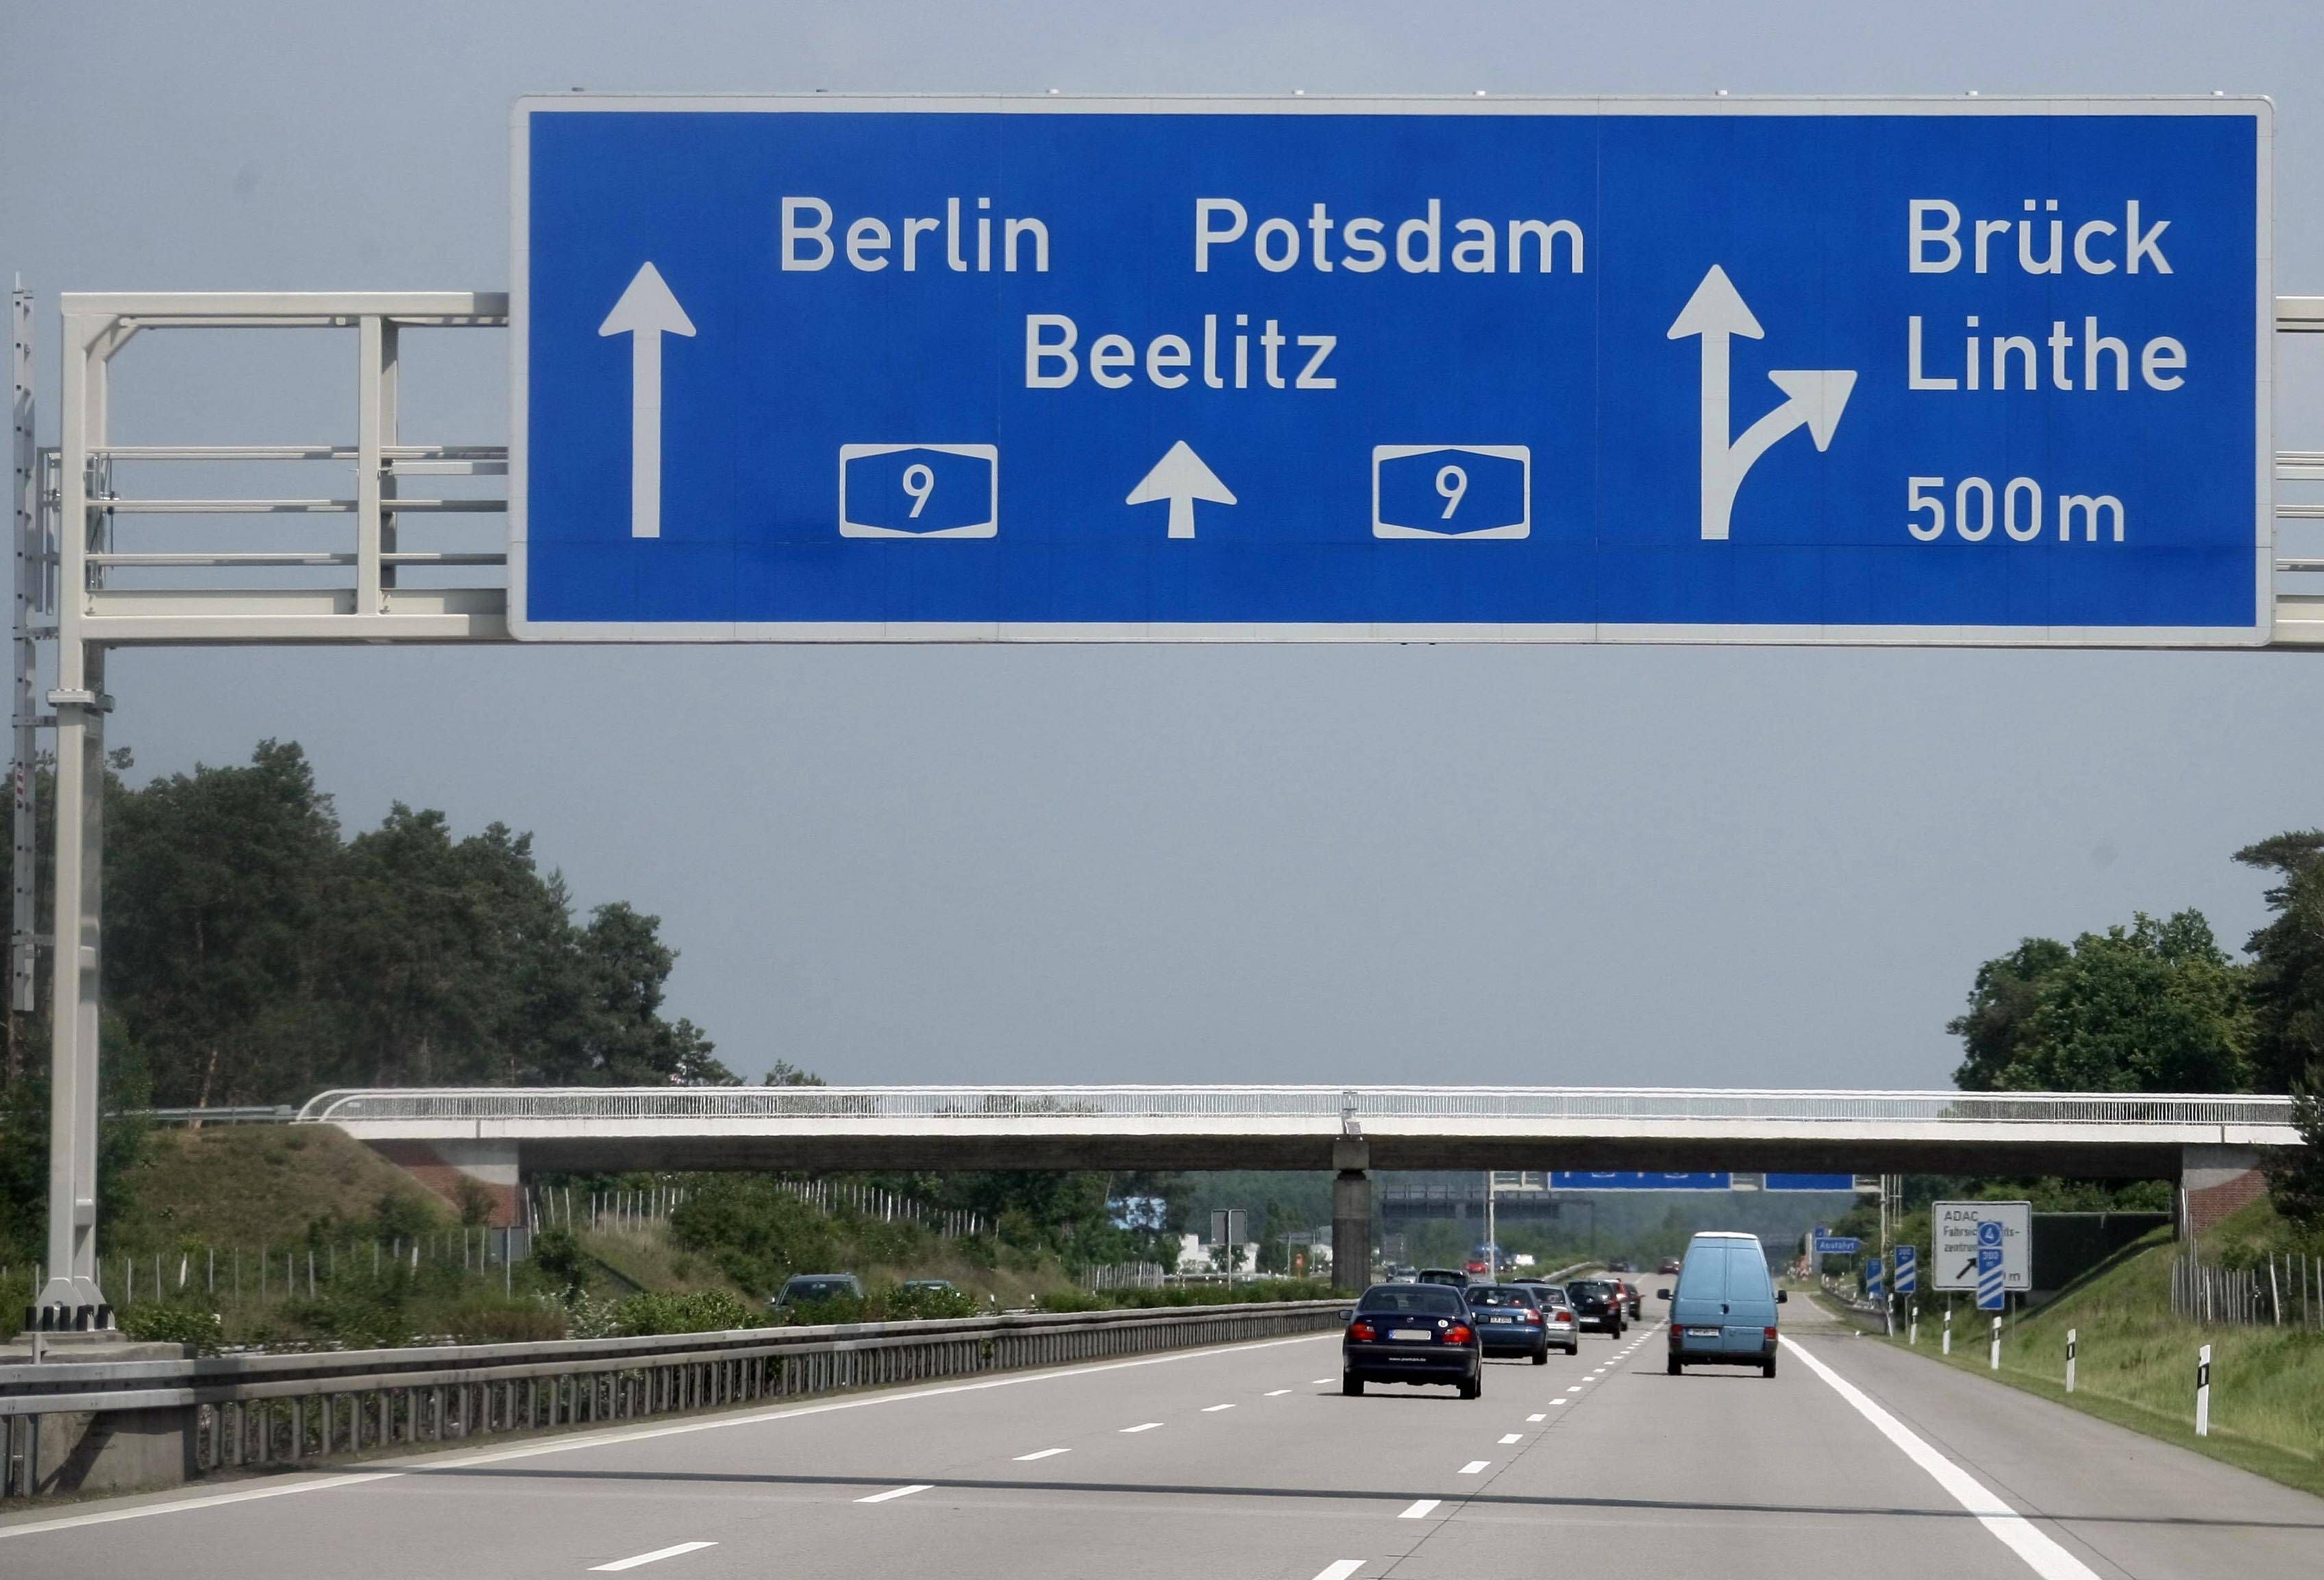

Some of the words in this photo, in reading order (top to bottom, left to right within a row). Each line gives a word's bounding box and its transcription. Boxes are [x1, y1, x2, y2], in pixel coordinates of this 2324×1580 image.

[782, 197, 1049, 272] Berlin
[1196, 198, 1583, 273] Potsdam
[1909, 199, 2173, 275] Brück
[1026, 314, 1337, 389] Beelitz
[1909, 316, 2187, 391] Linthe
[902, 464, 934, 518] 9
[1435, 465, 1468, 519] 9
[1944, 1211, 1979, 1222] ADAC
[1984, 1226, 1995, 1239] 4
